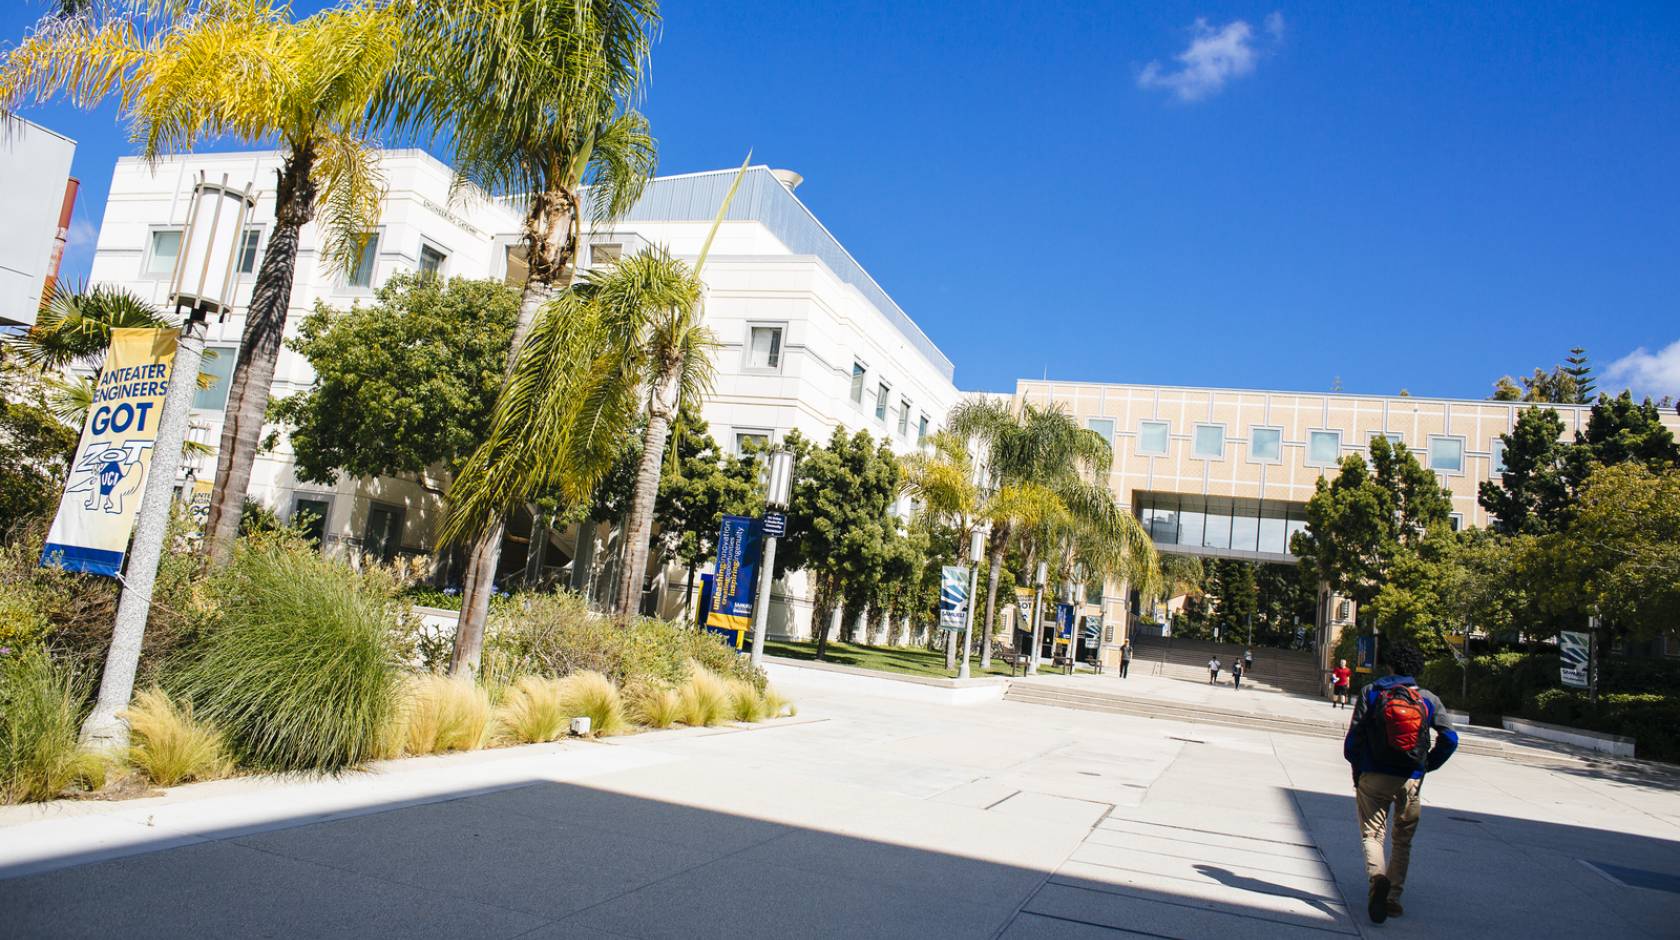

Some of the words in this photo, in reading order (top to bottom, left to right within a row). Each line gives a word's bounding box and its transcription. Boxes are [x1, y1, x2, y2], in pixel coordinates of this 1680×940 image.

[100, 363, 166, 386] ANTEATER
[92, 381, 168, 403] ENGINEERS
[91, 402, 154, 436] GOT
[75, 440, 155, 472] ZOT
[101, 471, 120, 486] UCI
[734, 526, 744, 561] ingenuity
[713, 562, 727, 610] unleashing
[721, 520, 731, 562] innovation
[730, 560, 740, 596] inspiring
